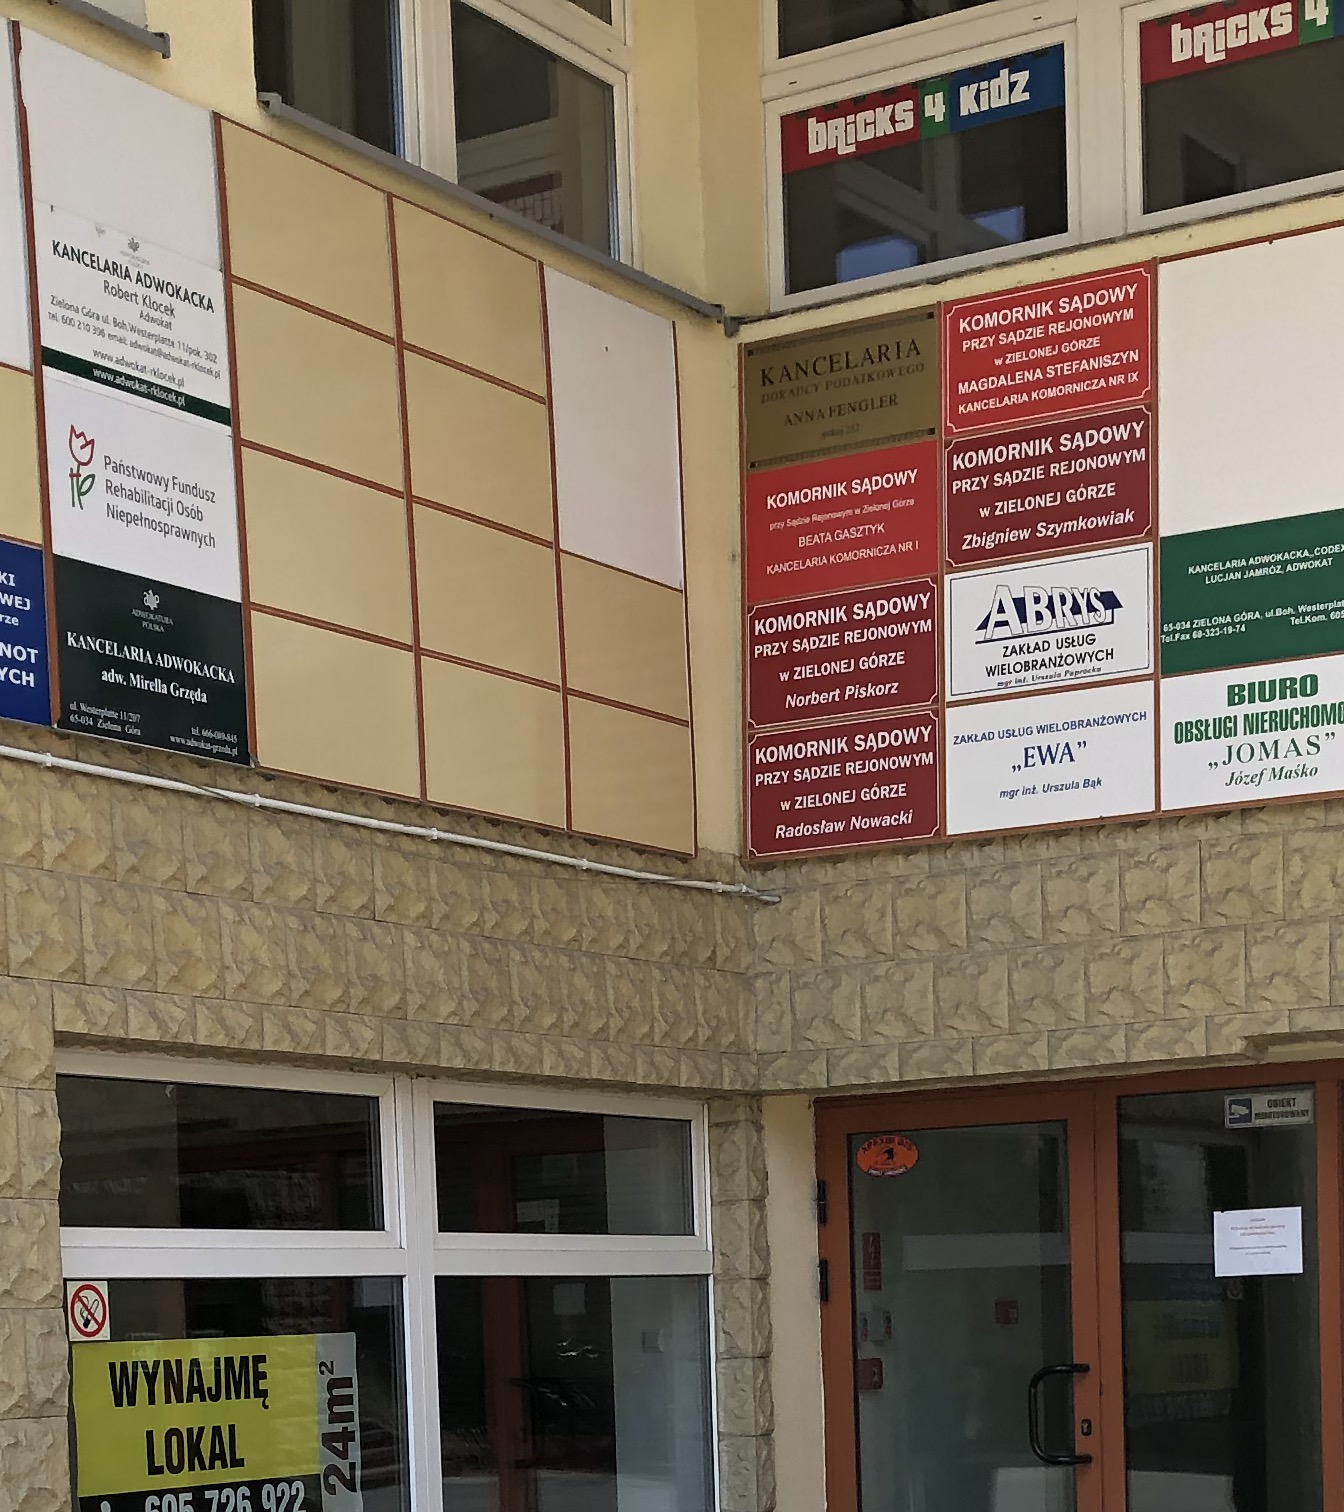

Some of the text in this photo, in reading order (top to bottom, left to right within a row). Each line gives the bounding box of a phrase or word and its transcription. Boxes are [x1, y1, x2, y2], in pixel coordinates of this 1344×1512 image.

[924, 92, 945, 123] 4
[52, 240, 214, 313] KANCELARIA ADWOKACKA
[104, 280, 175, 318] Robert Klocek
[959, 283, 1138, 333] KOMORNIK SĄDOWY
[140, 310, 172, 330] Adwokat
[761, 338, 921, 387] KANCELARIA
[958, 349, 1139, 394] MAGDALENA STEFANISZYN
[784, 393, 898, 427] ANNA FENGLER
[104, 455, 215, 503] Państwowy Fundusz
[767, 469, 918, 509] KOMORNIK SĄDOWY
[106, 479, 203, 521] Rehabilitacji Osób
[107, 503, 215, 548] Niepełnosprawnych
[799, 523, 885, 547] BEATA GASZTYK
[962, 508, 1135, 550] Zbigniew Szymkowiak
[1188, 559, 1247, 575] KANCELARIA
[1206, 558, 1334, 584] LUCJAN JAMRÓZ, ADWOKAT
[755, 592, 930, 635] KOMORNIK SĄDOWY
[984, 584, 1107, 639] ABRYS
[755, 619, 932, 658] PRZY SĄDZIE REJONOWYM
[1002, 633, 1096, 658] ZAKŁAD USŁUG
[67, 632, 235, 683] KANCELARIA ADWOKACKA
[779, 651, 905, 681] w ZIELONEJ GÓRZE
[985, 648, 1114, 677] WIELOBRANŻOWYCH
[101, 669, 208, 704] adw. Mirella Grzęda
[786, 682, 899, 708] Norbert Piskorz
[1227, 674, 1319, 707] BIURO
[953, 711, 1147, 745] ZAKŁAD USŁUG WIELOBRANŻOWYCH
[1174, 715, 1237, 744] OBSŁUGI
[1225, 764, 1318, 786] Józef Maśko
[775, 810, 913, 839] Radosław Nowacki
[1267, 1098, 1296, 1108] OBIEKT
[108, 1354, 269, 1410] WYNAJMĘ
[145, 1424, 245, 1476] LOKAL
